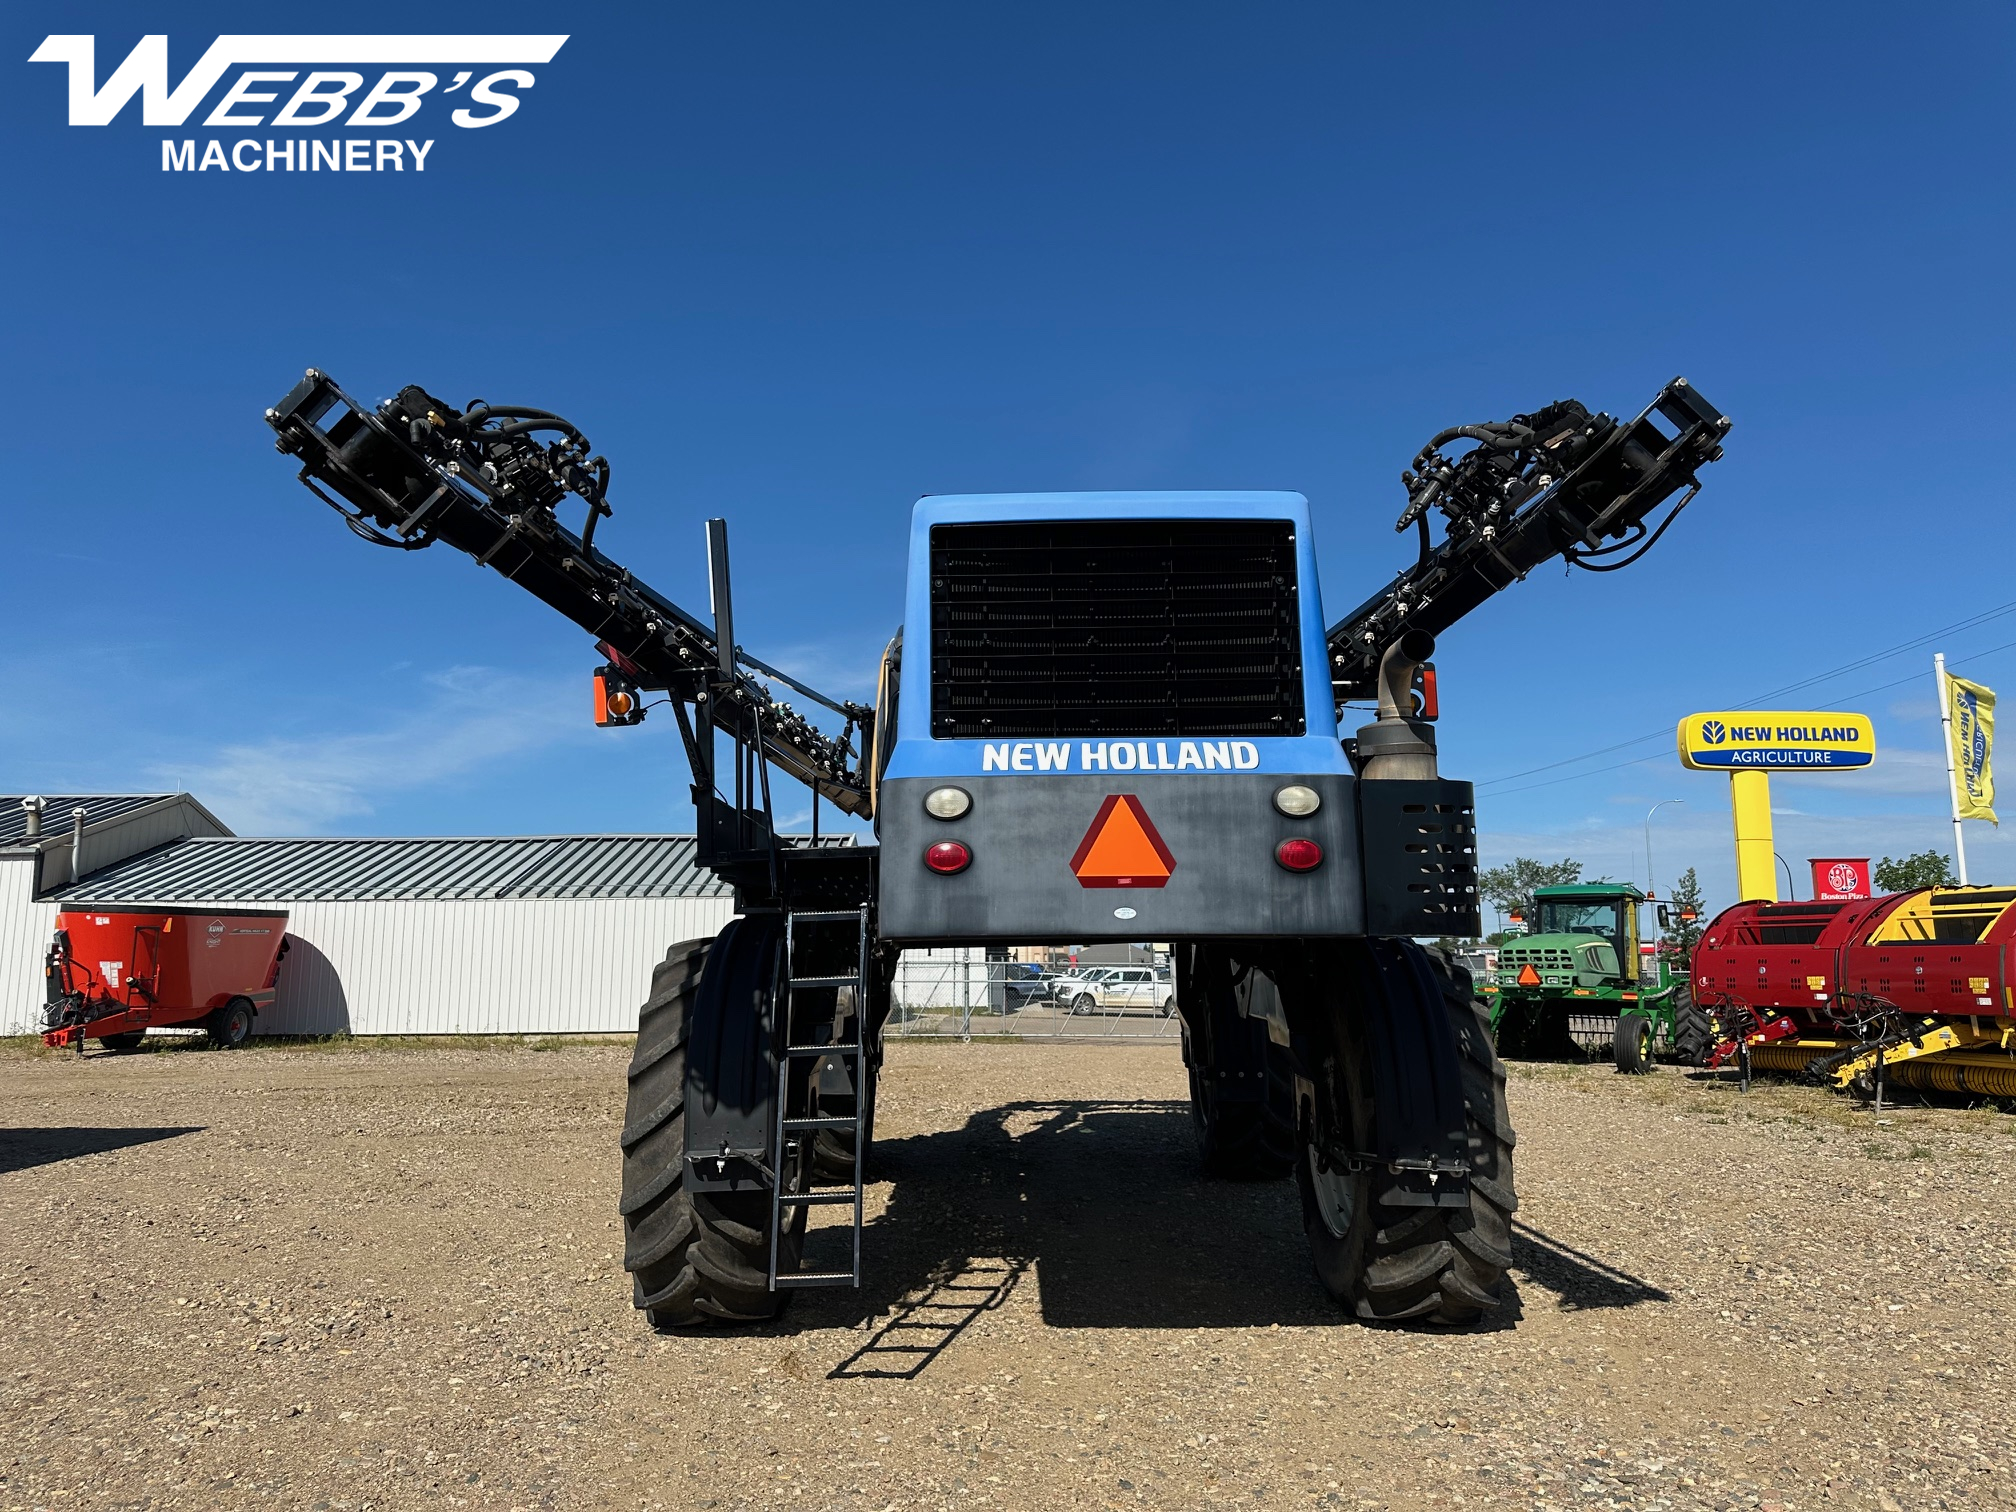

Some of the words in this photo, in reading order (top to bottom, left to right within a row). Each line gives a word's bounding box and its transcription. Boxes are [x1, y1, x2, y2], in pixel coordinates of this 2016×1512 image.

[1730, 726, 1771, 742] NEW
[1777, 727, 1859, 742] HOLLAND
[982, 743, 1071, 771] NEW
[1081, 741, 1261, 770] HOLLAND
[1731, 751, 1832, 763] AGRICULTURE
